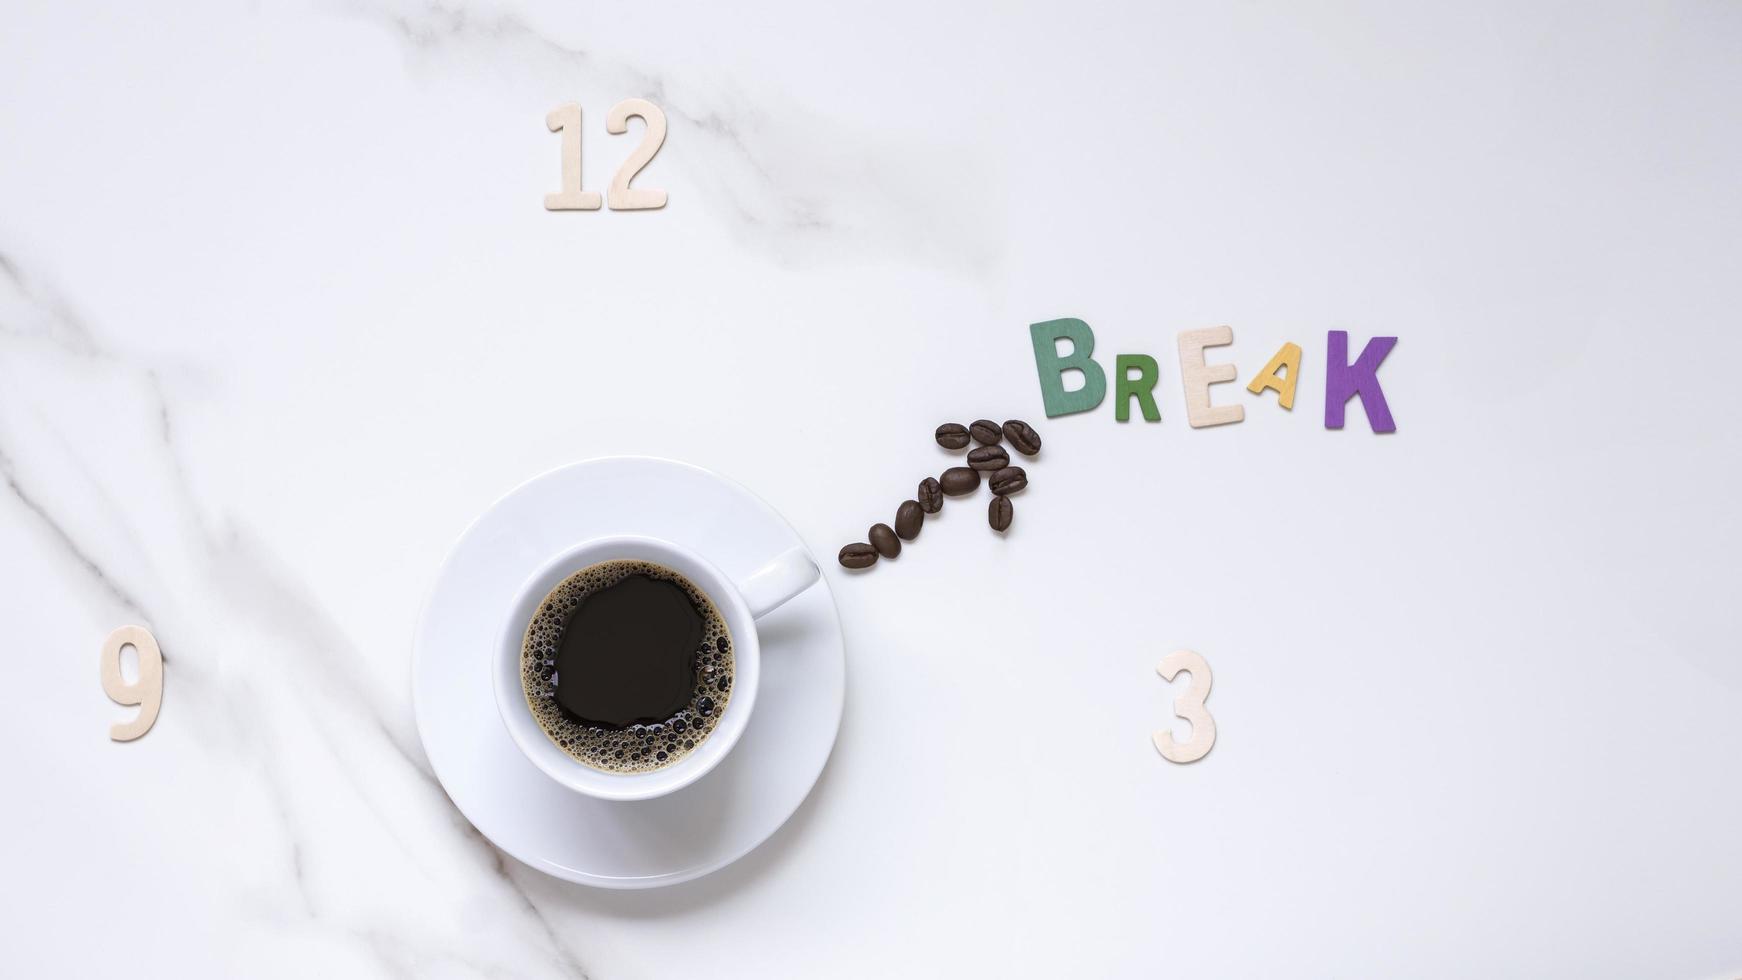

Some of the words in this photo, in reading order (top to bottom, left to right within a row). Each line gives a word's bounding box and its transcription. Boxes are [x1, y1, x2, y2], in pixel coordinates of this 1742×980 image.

[544, 98, 668, 211] 12
[1029, 317, 1399, 434] BREAK
[100, 624, 164, 743] 9
[1151, 649, 1217, 765] 3
